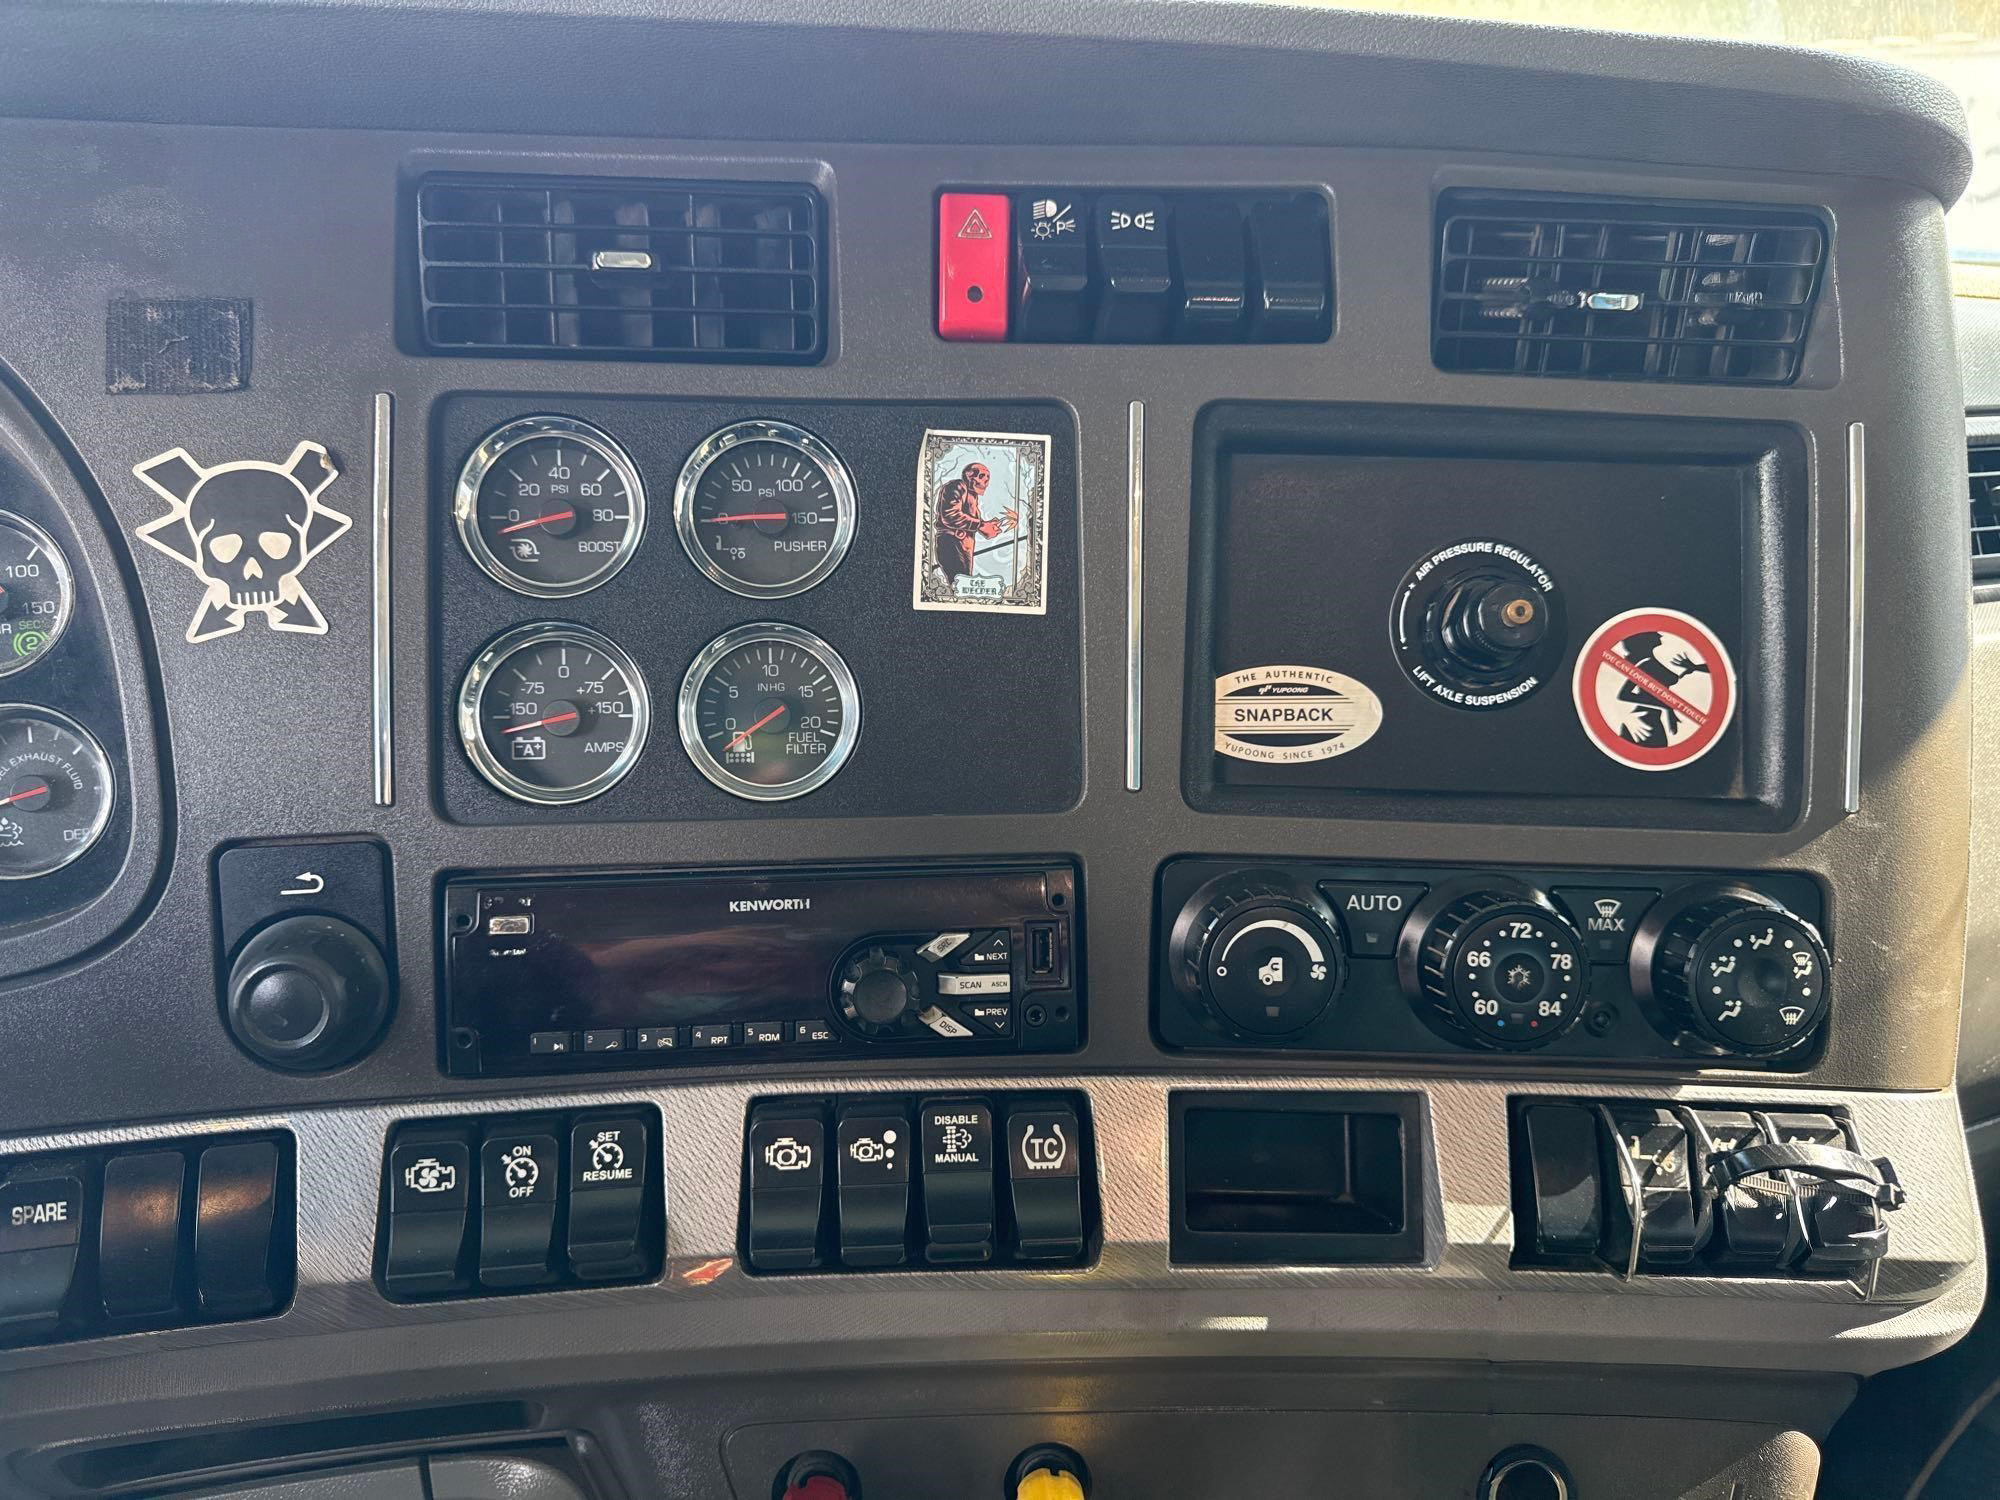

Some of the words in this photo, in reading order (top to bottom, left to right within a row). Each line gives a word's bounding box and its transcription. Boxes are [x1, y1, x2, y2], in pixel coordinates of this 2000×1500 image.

[549, 467, 570, 480] 40
[519, 484, 540, 496] 20
[551, 485, 569, 494] PSI
[581, 484, 602, 496] 60
[732, 480, 752, 492] 50
[776, 479, 803, 492] 100
[758, 488, 776, 497] PSI
[509, 510, 520, 521] 0
[593, 510, 614, 522] 80
[793, 512, 818, 525] 150
[578, 541, 622, 553] BOOST
[774, 541, 827, 552] PUSHER
[5, 564, 39, 578] 100
[1415, 562, 1434, 580] AIR
[1432, 542, 1494, 566] PRESSURE
[1494, 544, 1554, 593] REGULATOR
[962, 587, 997, 595] WELDER
[22, 601, 55, 614] 150
[26, 637, 39, 650] 2
[558, 666, 570, 678] 0
[762, 665, 779, 677] 10
[1235, 673, 1257, 684] THE
[1265, 670, 1334, 684] AUTHENTIC
[521, 682, 545, 695] -75
[576, 682, 604, 695] +75
[799, 686, 814, 698] 15
[1412, 665, 1436, 687] LIFT
[1433, 684, 1463, 704] AXLE
[1464, 676, 1540, 706] SUSPENSION
[1602, 651, 1617, 664] YOU
[1615, 660, 1631, 672] CAN
[1629, 669, 1649, 686] LOOK
[1647, 682, 1662, 694] BUT
[1660, 691, 1683, 709] DON'T
[1682, 705, 1707, 725] TOUCH
[728, 687, 738, 699] 5
[589, 702, 624, 714] +150
[1234, 708, 1334, 722] SNAPBACK
[726, 718, 736, 730] 0
[800, 717, 821, 729] 20
[788, 732, 821, 743] FUEL
[584, 742, 625, 753] AMPS
[786, 744, 827, 755] FILTER
[1225, 741, 1275, 759] YUPOONG
[1282, 749, 1313, 760] SINCE
[1321, 742, 1345, 755] 1974
[9, 751, 63, 767] EXHAUST
[61, 762, 83, 790] FLUID
[729, 898, 810, 912] KENWORTH
[1347, 895, 1401, 911] AUTO
[1509, 922, 1533, 939] 72
[1588, 919, 1624, 932] MAX
[937, 938, 952, 952] SRC
[986, 952, 1008, 960] NEXT
[1466, 951, 1491, 967] 66
[1550, 953, 1573, 970] 78
[960, 981, 982, 989] SCAN
[985, 1008, 1008, 1016] PREV
[1474, 999, 1499, 1016] 60
[1538, 1000, 1562, 1017] 84
[799, 1026, 806, 1034] 6
[811, 1031, 829, 1040] ESC
[939, 1020, 957, 1034] DISP
[640, 1034, 648, 1042] 3
[695, 1031, 702, 1039] 4
[711, 1036, 728, 1045] RPT
[747, 1028, 754, 1036] 5
[759, 1033, 780, 1042] RDM
[934, 1115, 978, 1125] DISABLE
[597, 1131, 621, 1142] SET
[512, 1145, 532, 1157] ON
[1030, 1138, 1059, 1160] TC
[935, 1153, 979, 1163] MANUAL
[582, 1168, 633, 1182] RESUME
[509, 1186, 535, 1198] OFF
[11, 1201, 67, 1225] SPARE
